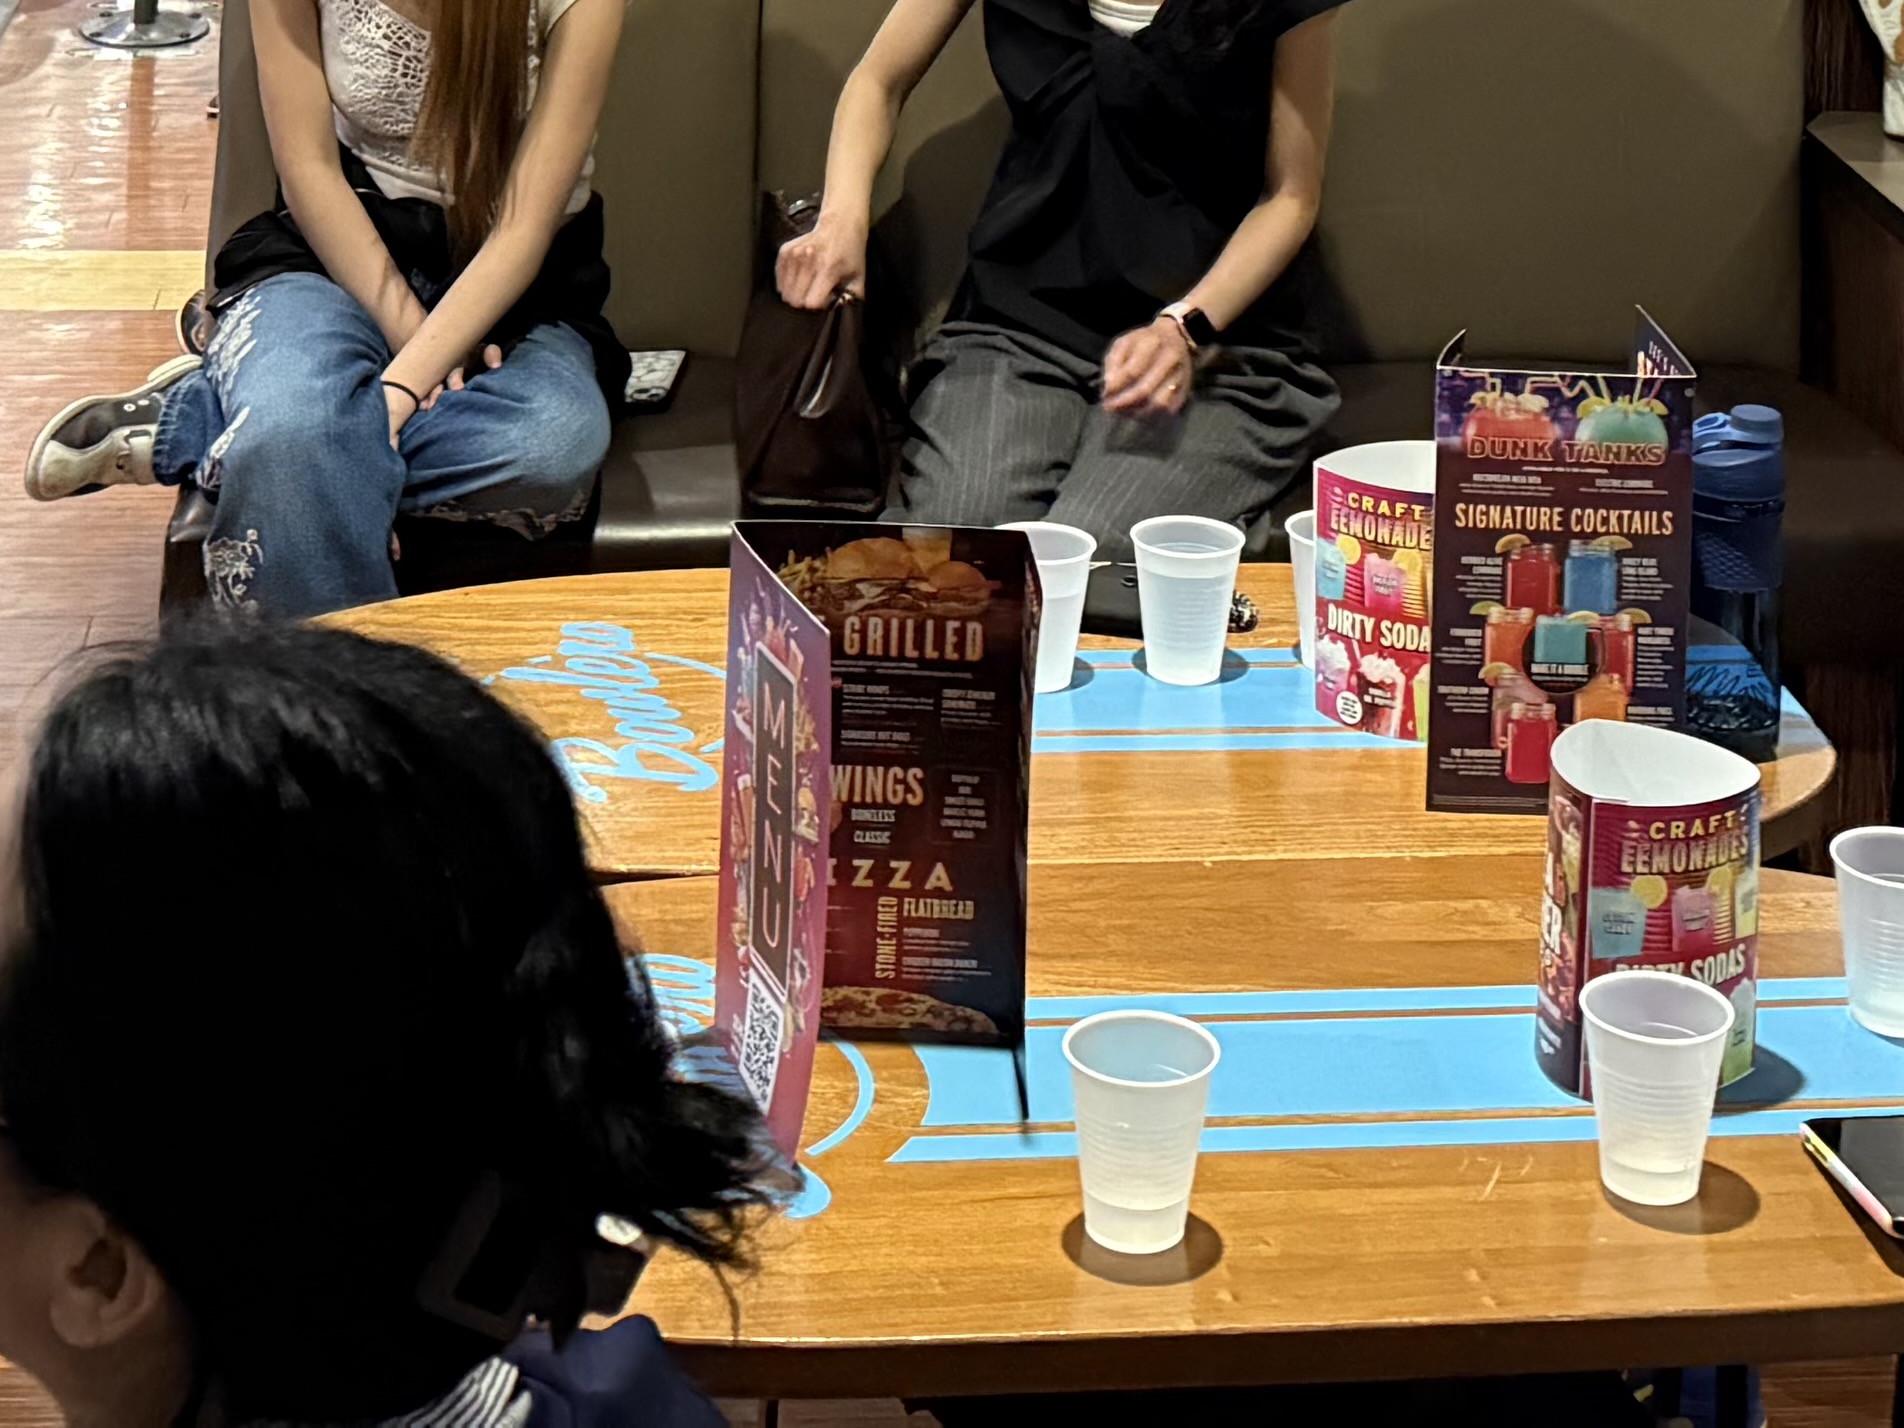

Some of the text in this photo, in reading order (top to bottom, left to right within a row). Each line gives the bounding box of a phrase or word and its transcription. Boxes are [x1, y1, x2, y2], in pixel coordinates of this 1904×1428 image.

[1467, 437, 1665, 465] DUNK TANKS
[1347, 492, 1425, 521] CRAFT
[1454, 503, 1674, 536] SIGNATURE COCKTAILS
[1330, 505, 1433, 550] LEMONADE
[843, 615, 984, 662] GRILLED
[1328, 603, 1432, 652] DIRTY SODA
[831, 764, 924, 806] WINGS
[762, 682, 785, 949] MENU
[1649, 810, 1735, 839] CRAFT
[827, 858, 953, 892] IZZA
[903, 898, 975, 920] FLATBREAD
[1691, 943, 1746, 987] SODAS
